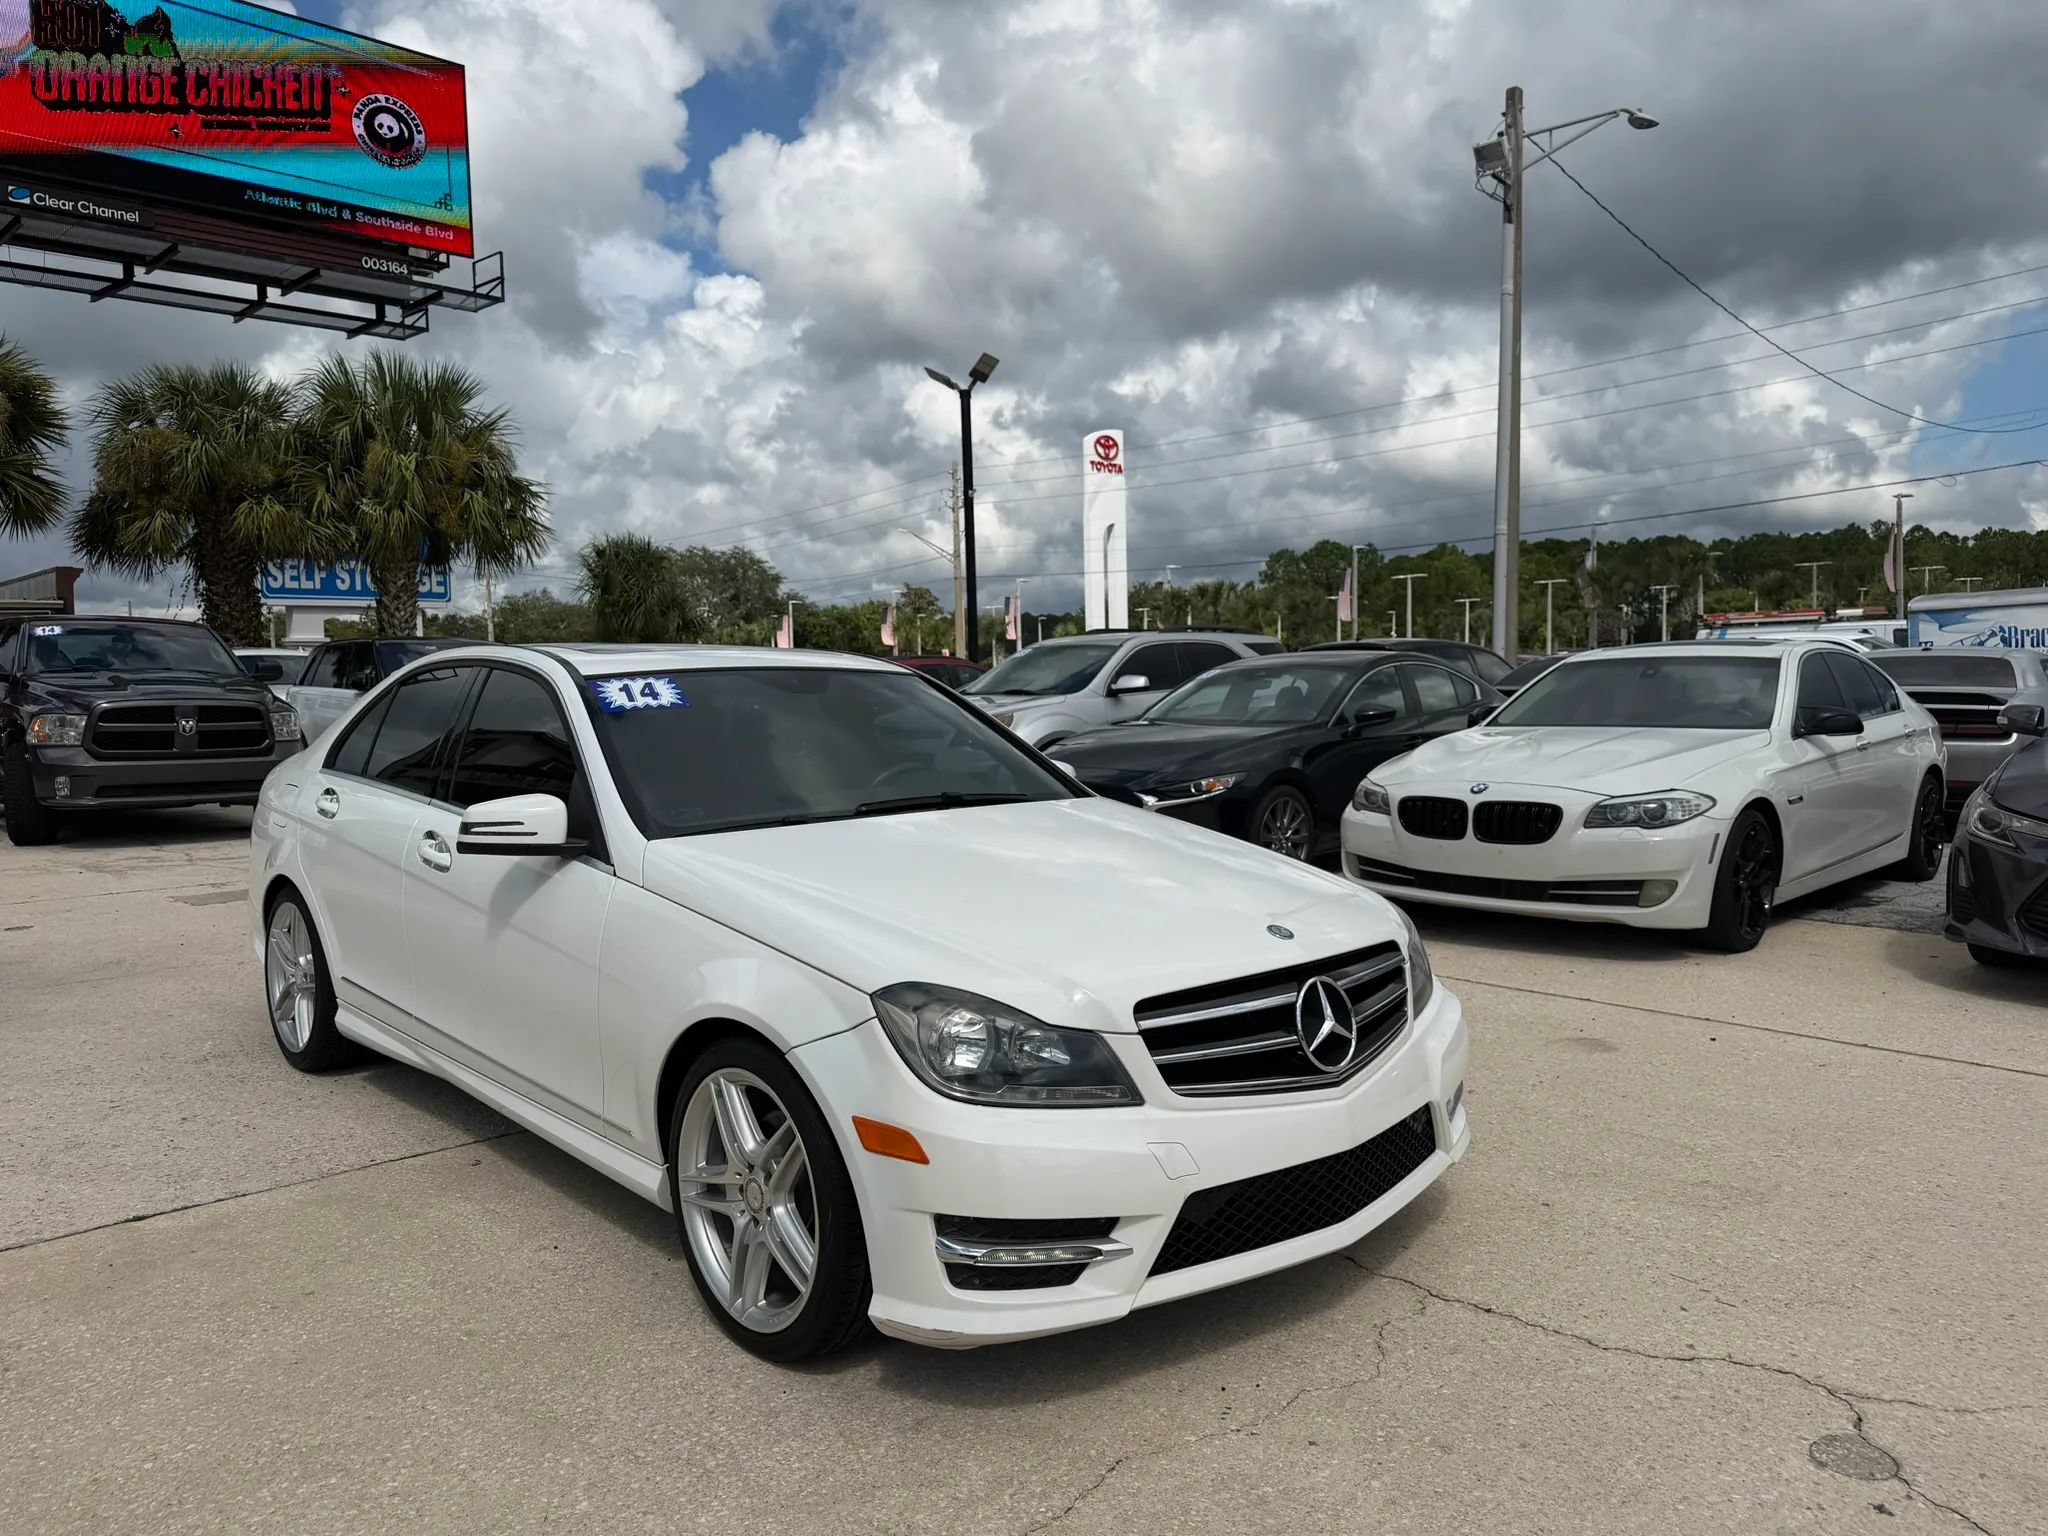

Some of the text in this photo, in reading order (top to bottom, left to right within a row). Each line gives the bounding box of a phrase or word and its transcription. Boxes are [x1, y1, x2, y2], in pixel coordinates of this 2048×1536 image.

[33, 50, 323, 111] ORANGE CHICKEN
[353, 96, 423, 135] PANDA EXPRESS
[33, 192, 139, 222] Clear Channel
[243, 188, 302, 210] Atlantic
[306, 201, 339, 218] Blvd
[355, 211, 422, 234] Southside
[425, 226, 454, 241] Blvd
[361, 256, 409, 275] 003164
[1089, 460, 1123, 474] TOYOTA
[267, 560, 326, 590] SELF
[618, 682, 660, 702] 14
